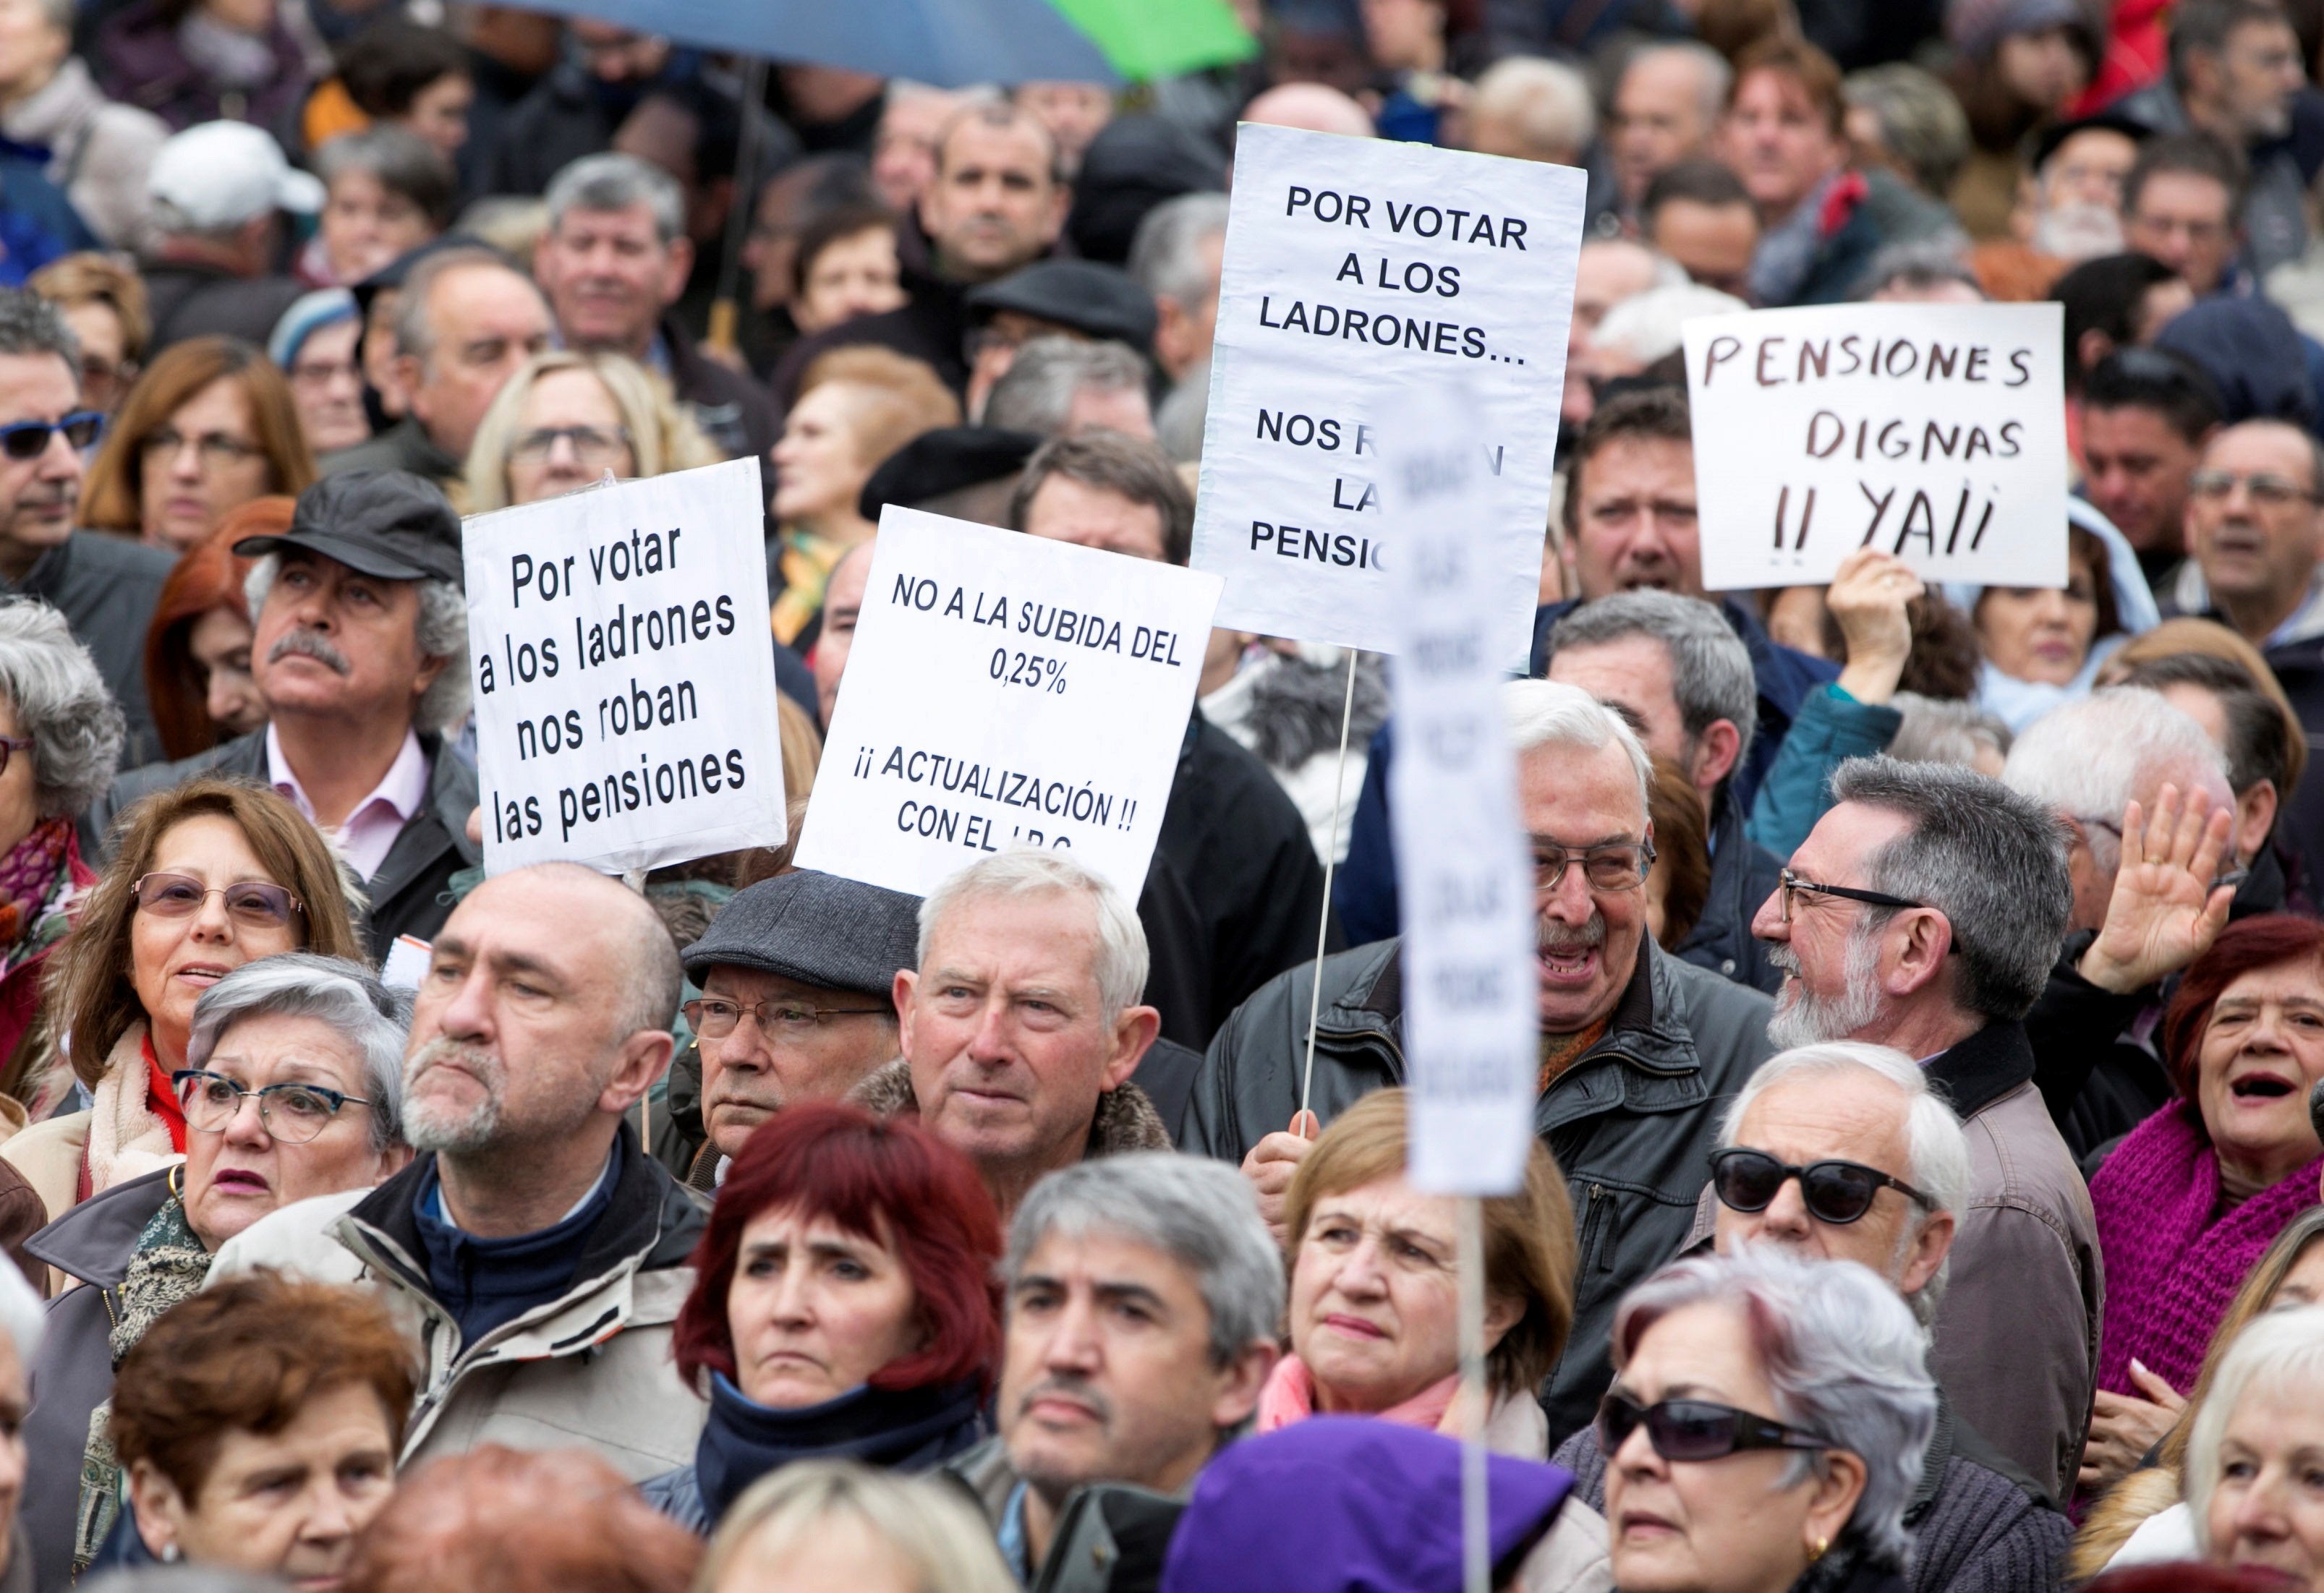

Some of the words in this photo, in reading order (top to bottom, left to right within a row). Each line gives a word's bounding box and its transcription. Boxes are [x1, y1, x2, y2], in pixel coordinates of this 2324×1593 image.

[1286, 185, 1371, 229] POR
[1386, 200, 1528, 251] VOTAR
[1335, 252, 1364, 285] A
[1378, 257, 1460, 298] LOS
[1259, 296, 1525, 365] LADRONES...
[1703, 335, 2033, 388] PENSIONES
[1256, 408, 1341, 451] NOS
[1805, 409, 2025, 463] DIGNAS
[1333, 479, 1382, 514] LA
[511, 553, 575, 609] Por
[589, 527, 681, 586] votar
[1251, 521, 1389, 571] PENSI
[480, 654, 495, 695] a
[505, 633, 559, 686] los
[576, 594, 735, 670] ladrones
[891, 573, 938, 611] NO
[943, 586, 963, 620] A
[973, 591, 1007, 629] LA
[1018, 601, 1120, 654] SUBIDA
[1131, 625, 1180, 667] DEL
[989, 648, 1067, 694] 0,25%
[516, 709, 583, 761] nos
[599, 678, 697, 742] roban
[493, 790, 542, 844] las
[559, 748, 745, 843] pensiones
[881, 746, 1113, 826] ACTUALIZACIÓN
[898, 800, 960, 842] CON
[963, 815, 997, 853] EL
